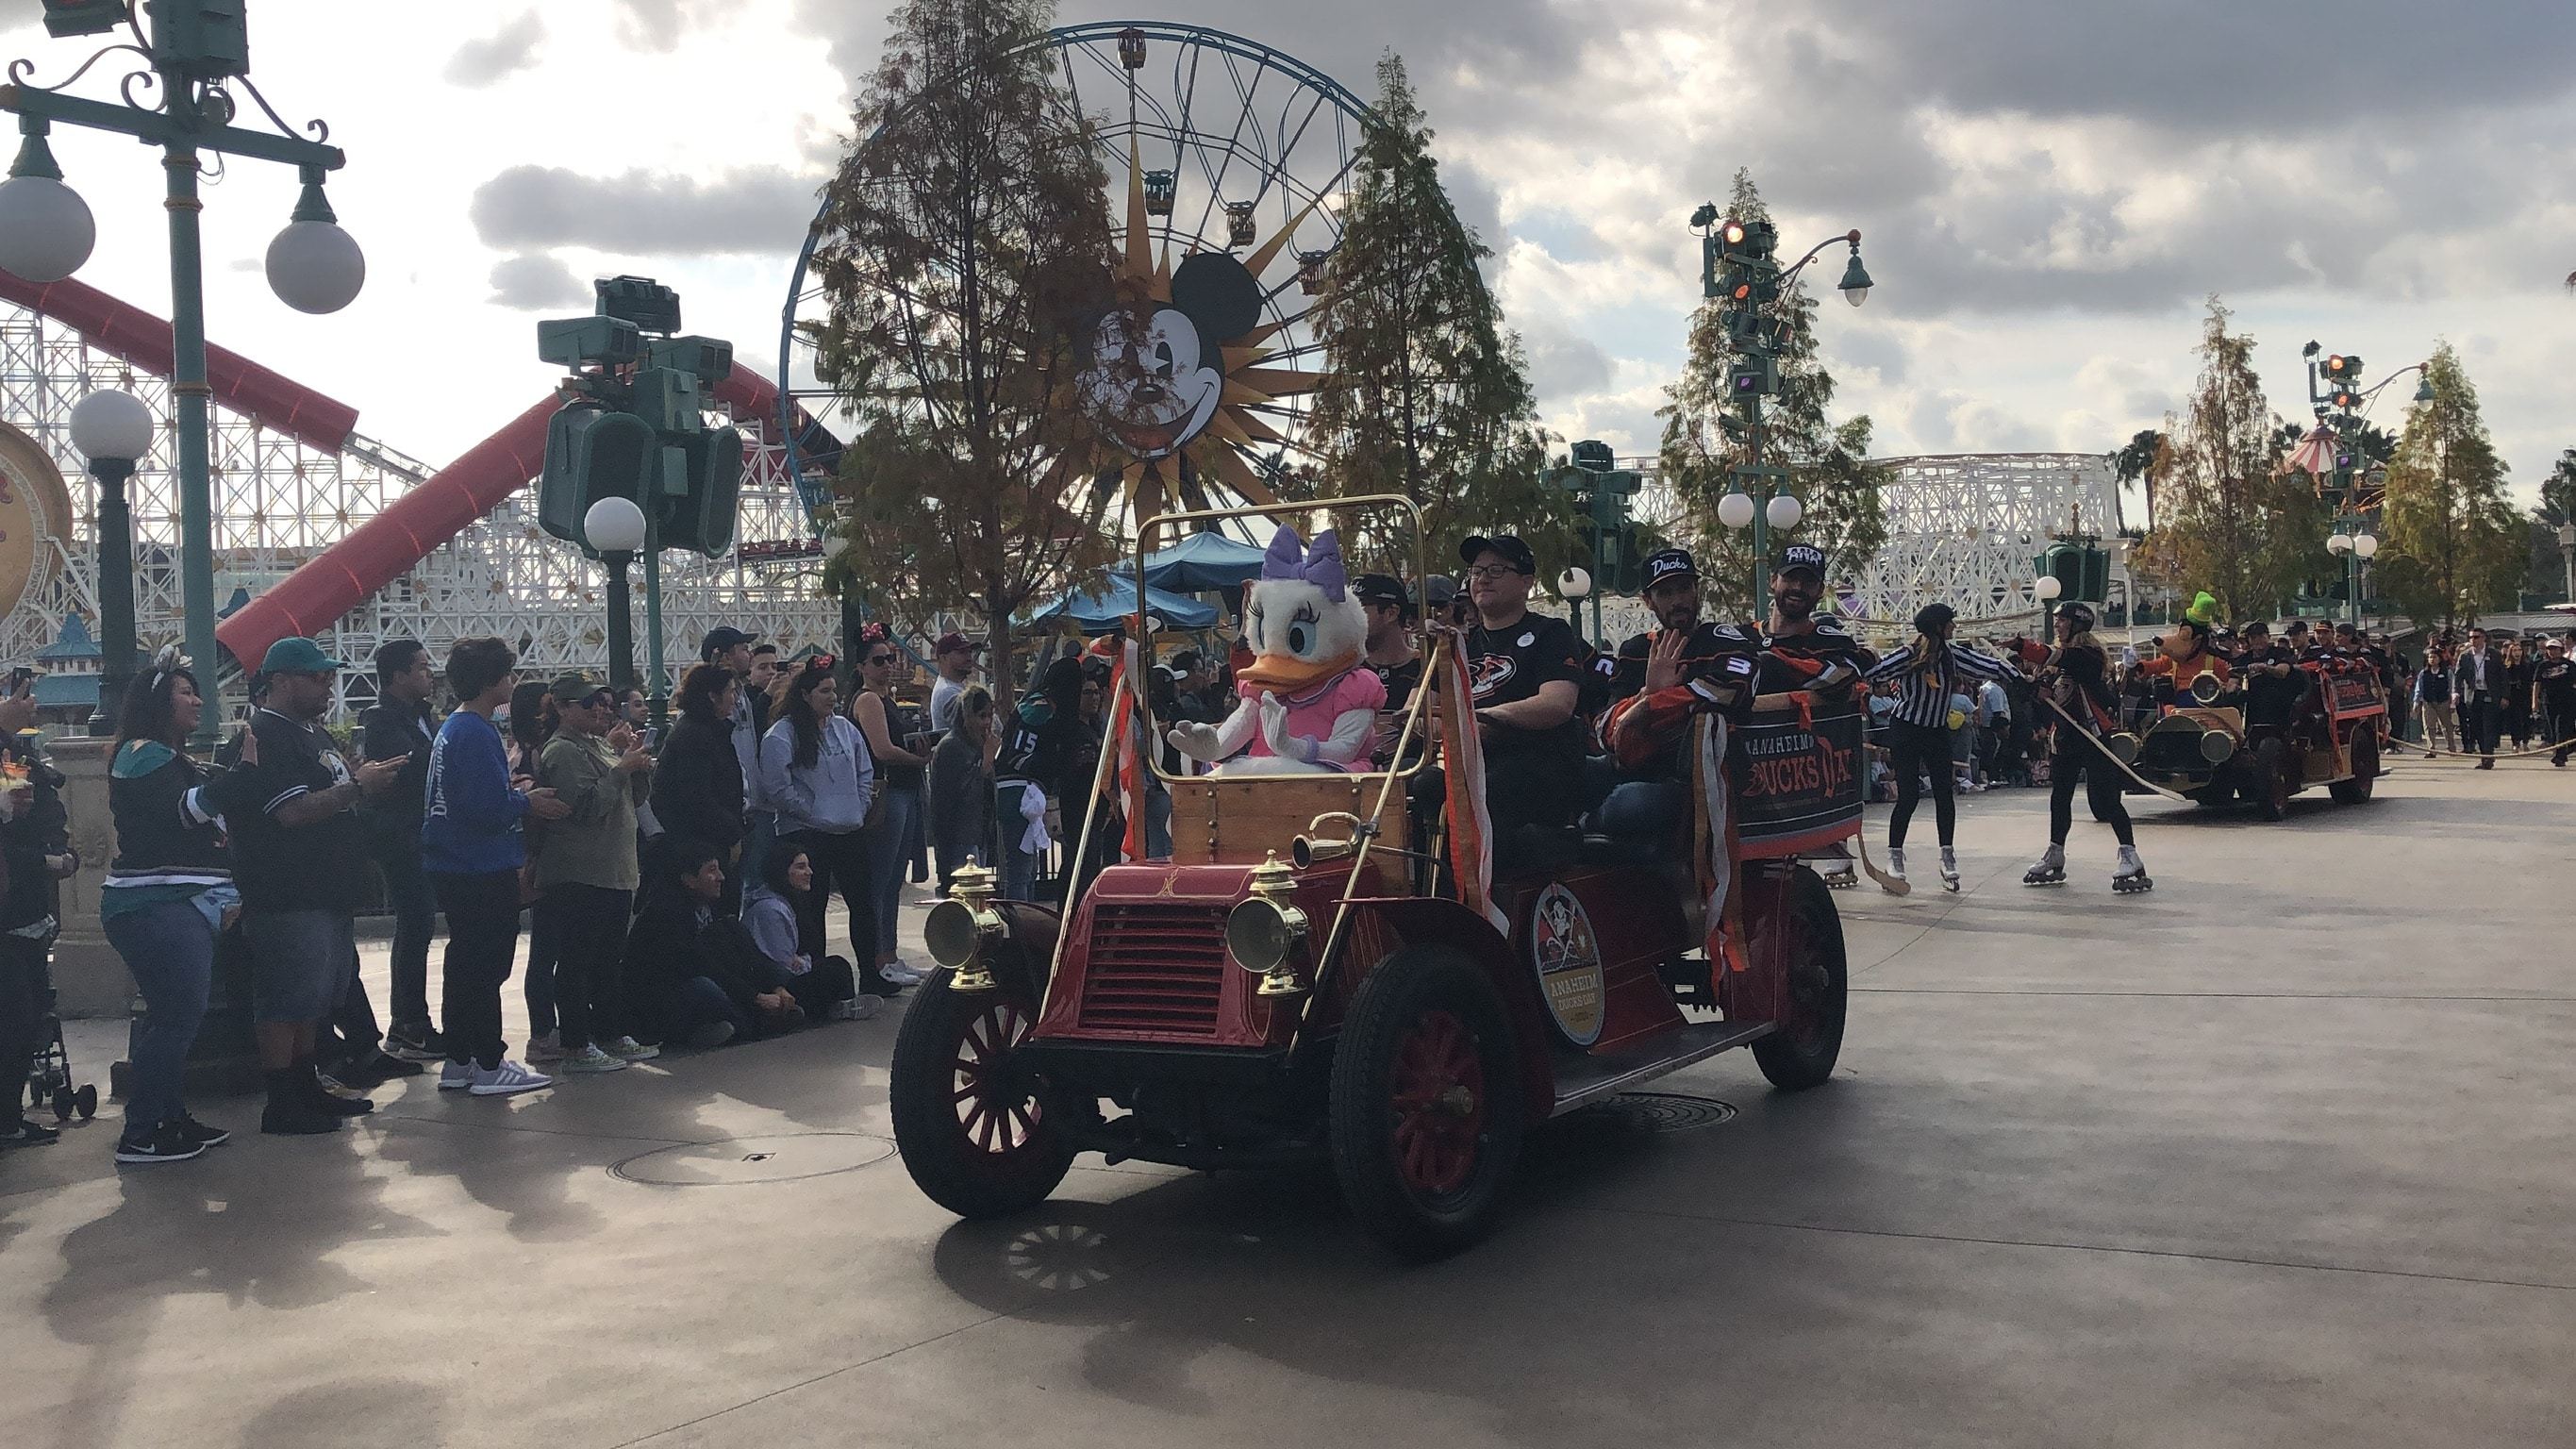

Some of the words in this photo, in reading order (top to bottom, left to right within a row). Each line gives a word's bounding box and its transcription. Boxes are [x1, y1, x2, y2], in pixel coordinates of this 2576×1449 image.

[1651, 557, 1688, 577] Ducks
[1014, 729, 1039, 754] 15
[1752, 733, 1809, 755] ANAHEIM
[1550, 973, 1599, 997] ANAHEIM
[1557, 994, 1584, 1011] DUCKS
